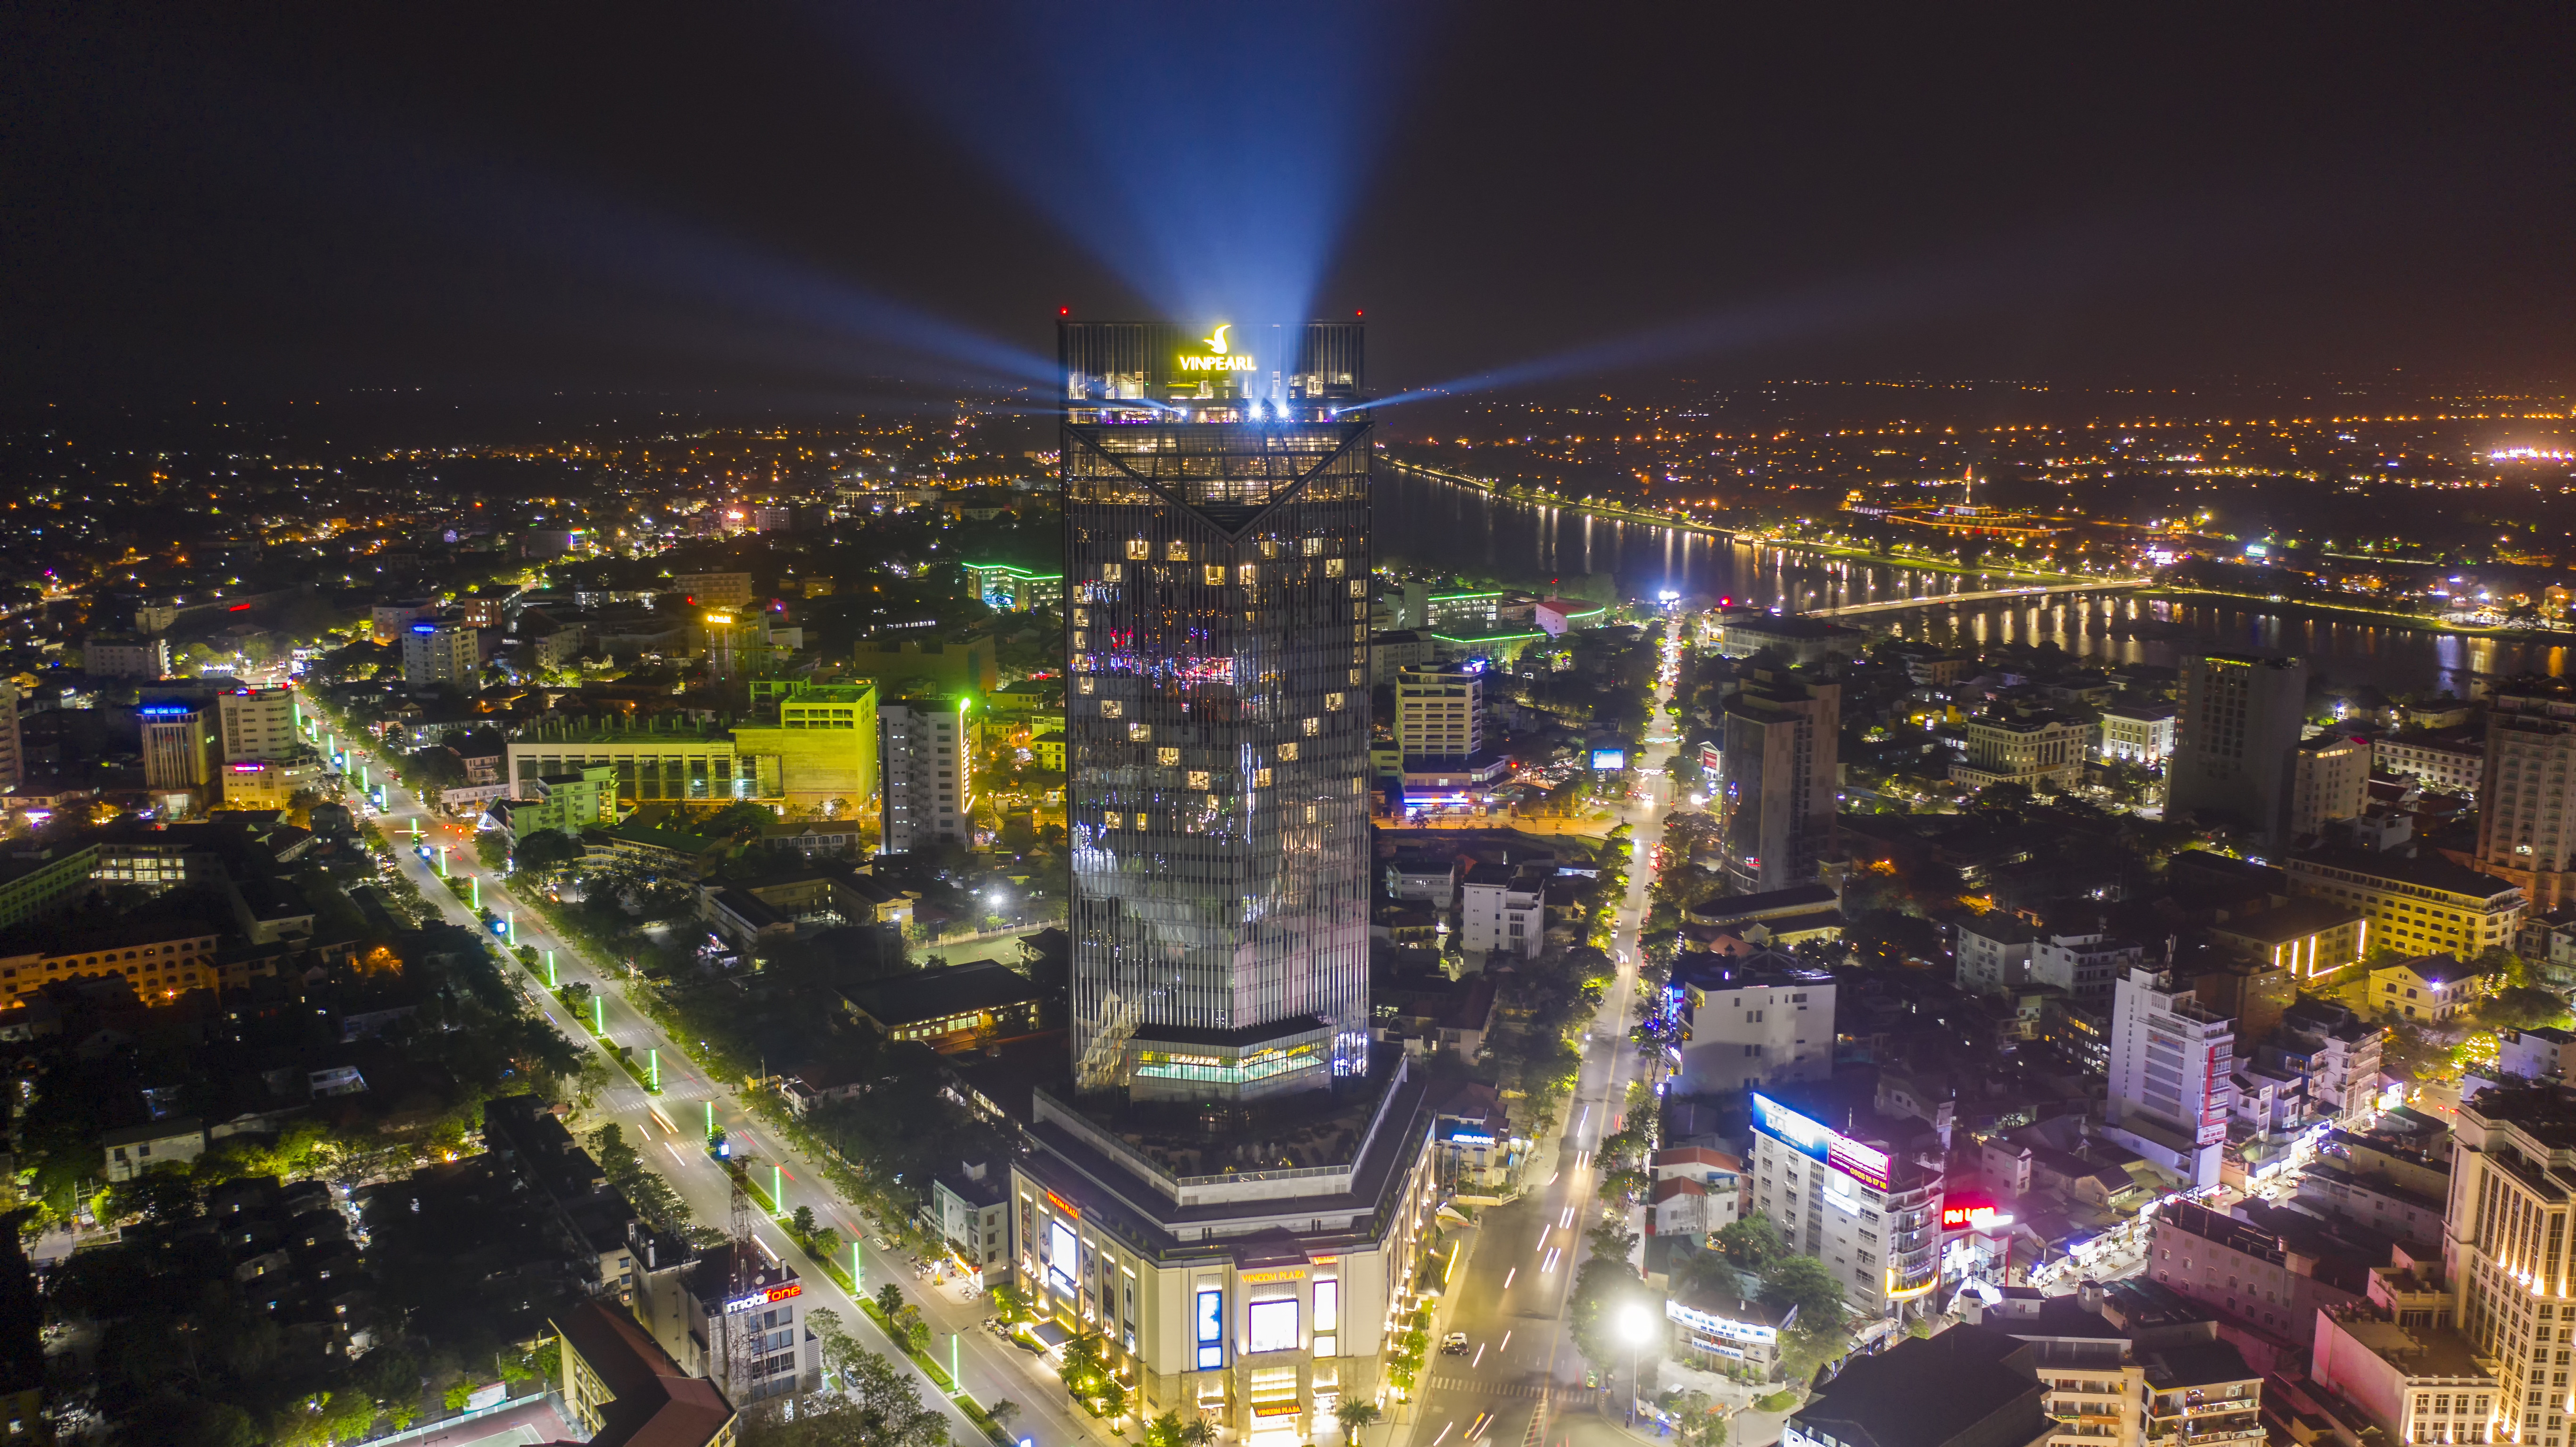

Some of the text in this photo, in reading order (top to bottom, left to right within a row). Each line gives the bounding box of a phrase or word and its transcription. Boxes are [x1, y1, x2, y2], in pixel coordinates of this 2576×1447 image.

[1179, 356, 1257, 371] VINPEARL
[1048, 1192, 1079, 1220] VINCOM PLAZA
[1241, 1269, 1307, 1283] VINCOM PLAZA
[727, 1285, 801, 1313] mobifone
[1256, 1406, 1301, 1416] VINCOM PLAZA
